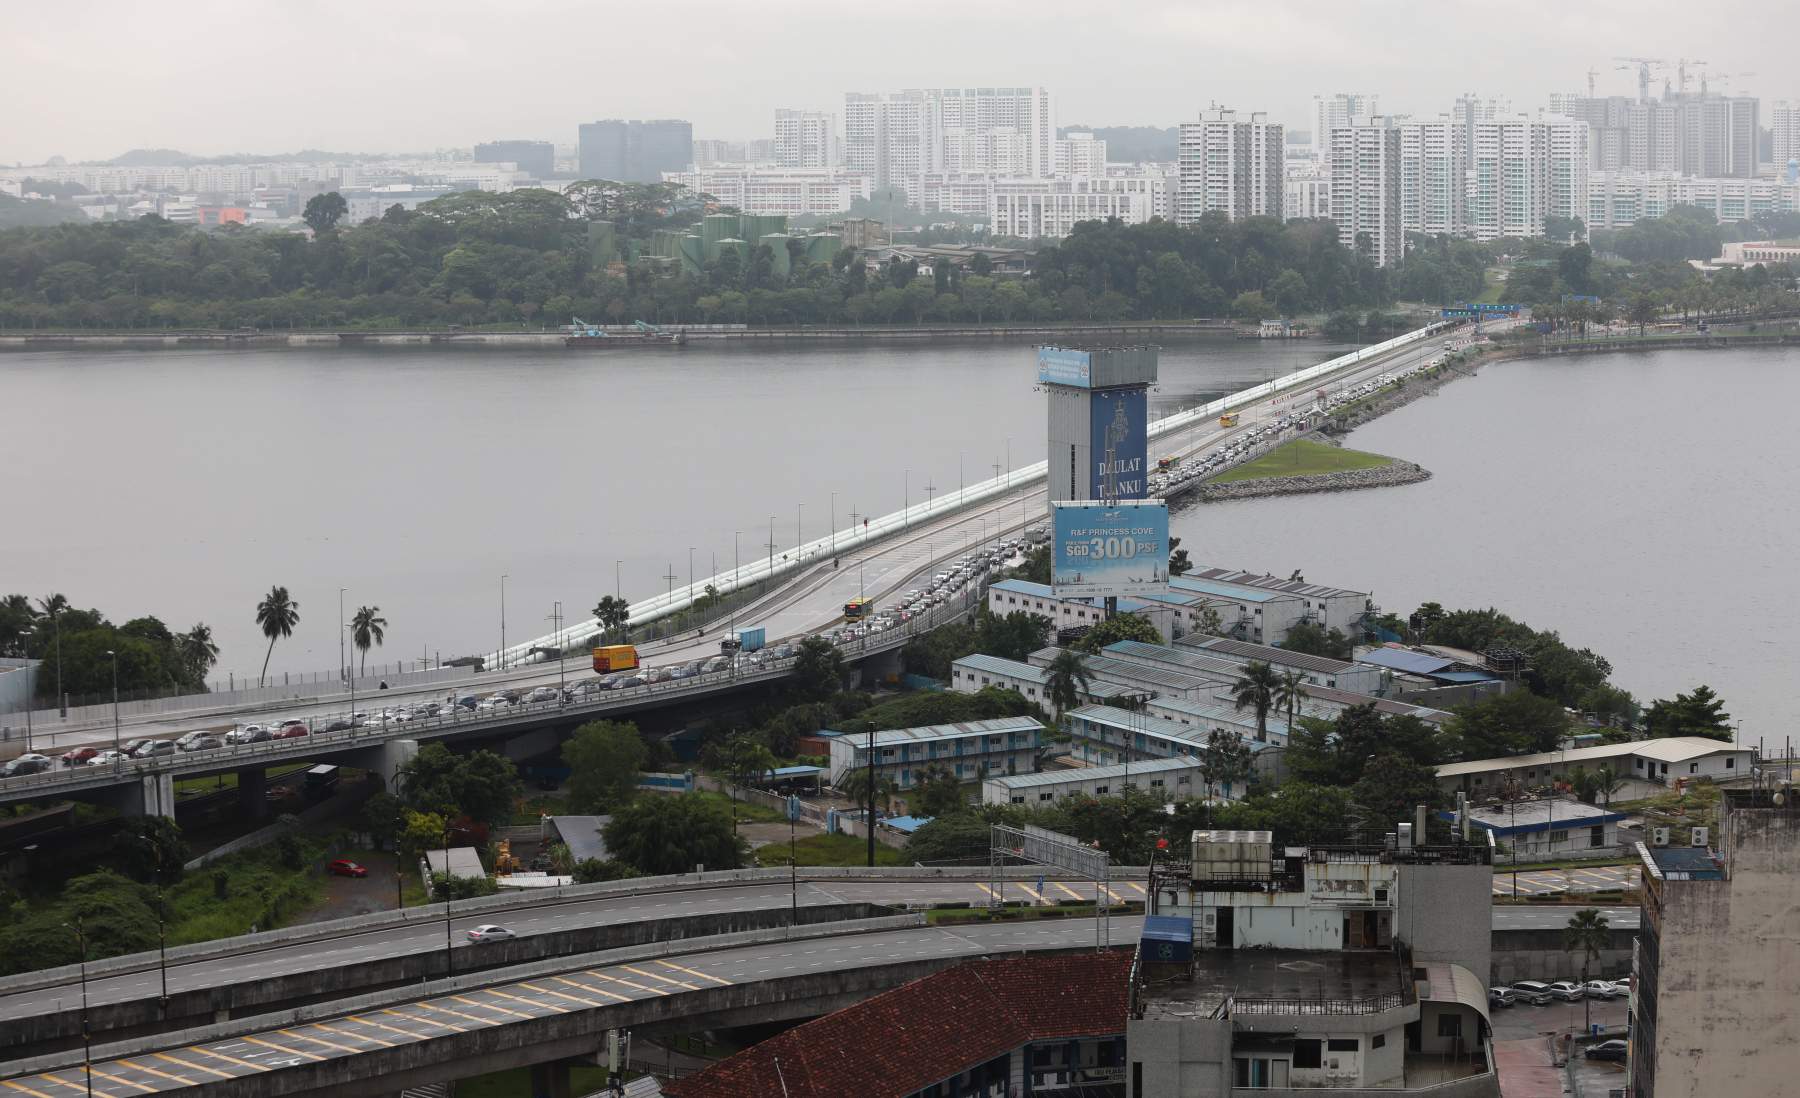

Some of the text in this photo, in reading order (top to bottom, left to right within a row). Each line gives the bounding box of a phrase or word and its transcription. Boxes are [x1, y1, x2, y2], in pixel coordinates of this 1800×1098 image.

[1098, 480, 1141, 498] TANKU
[1089, 528, 1130, 536] PRINCESS
[1131, 527, 1154, 535] COVE
[1066, 537, 1158, 559] SGD 300 PSF
